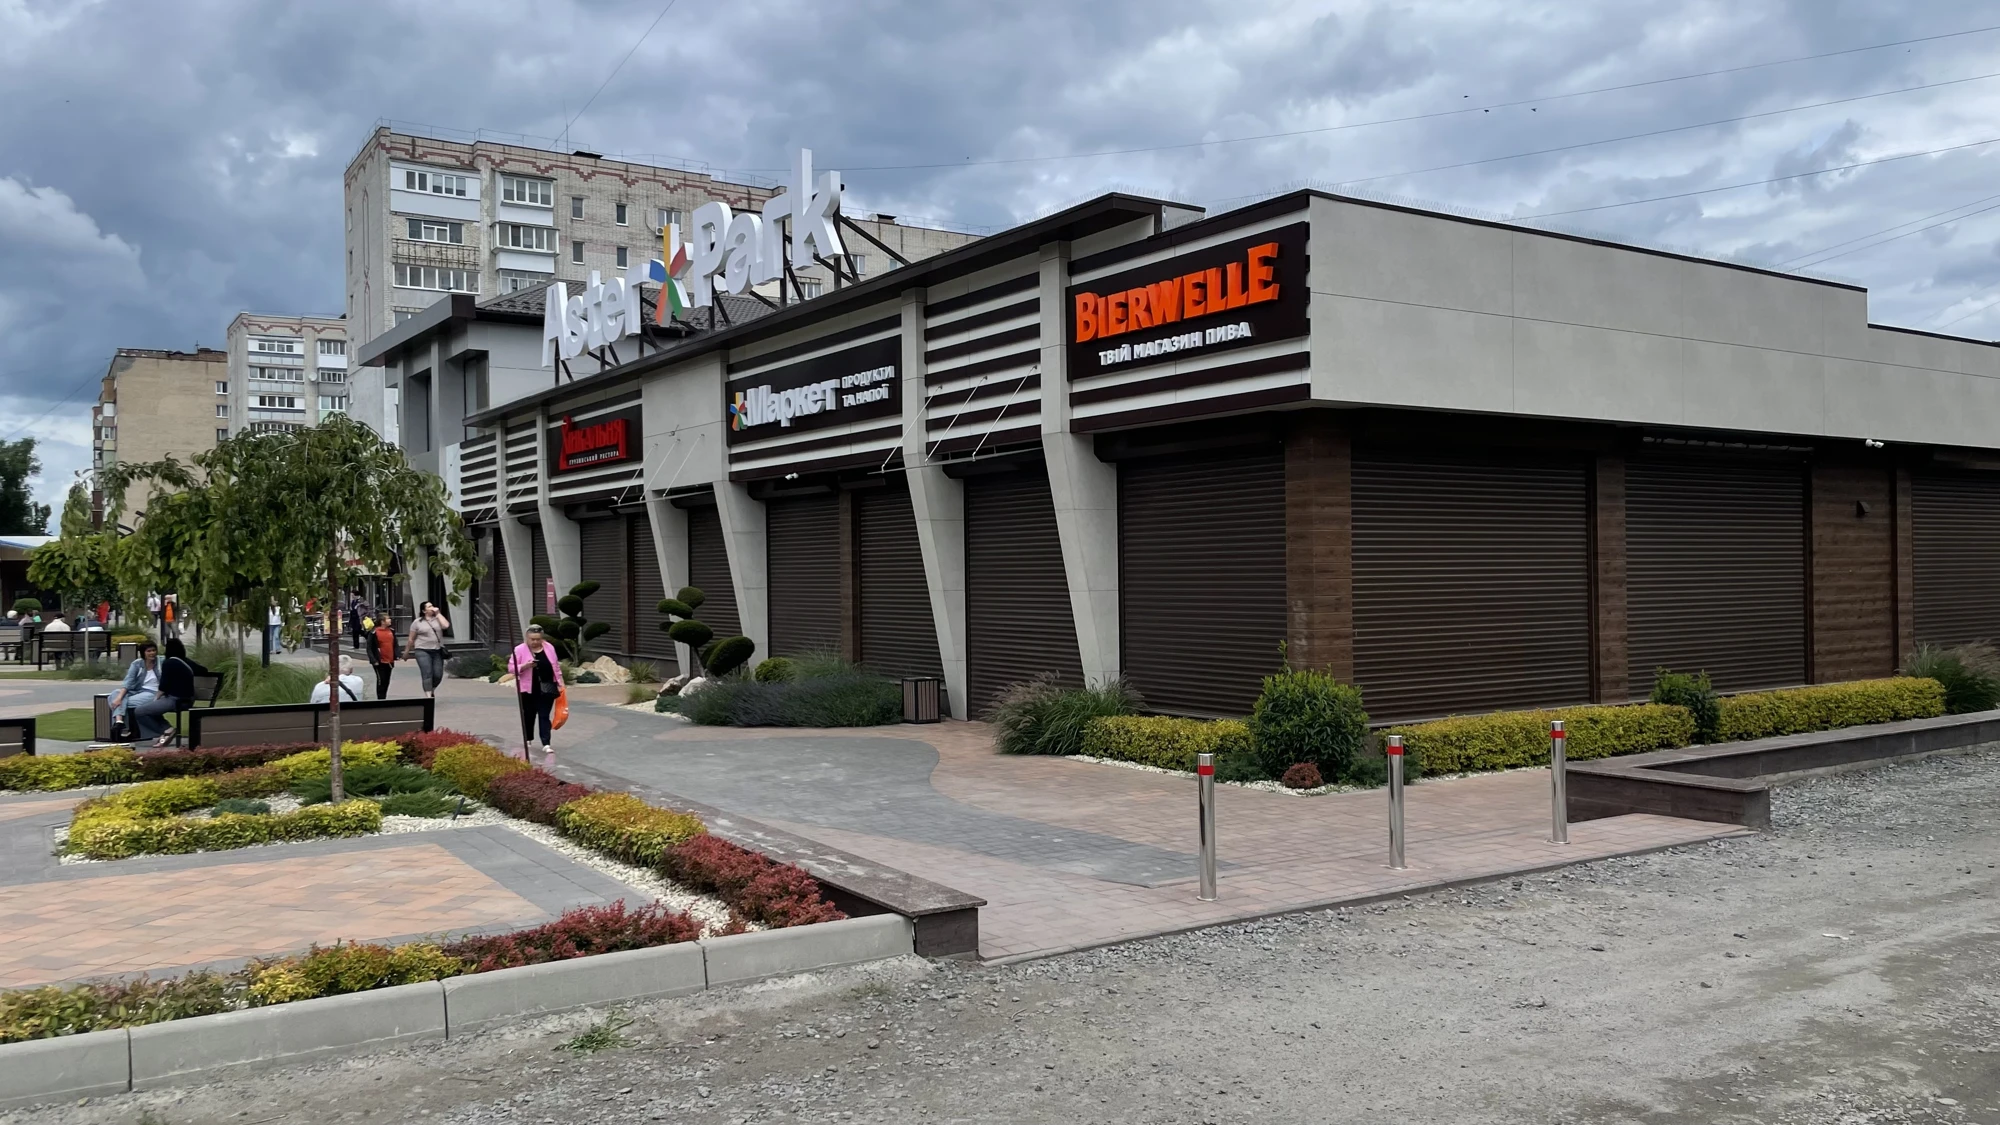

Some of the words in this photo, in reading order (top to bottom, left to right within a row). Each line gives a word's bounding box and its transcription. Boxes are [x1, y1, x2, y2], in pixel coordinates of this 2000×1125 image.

[542, 263, 650, 367] Aster
[692, 148, 844, 309] Park
[1075, 242, 1280, 343] BIERWELLE
[1099, 343, 1131, 366] ТВІЙ
[1133, 331, 1203, 359] МАГАЗИН
[1205, 322, 1252, 344] ПИВА
[842, 366, 895, 388] ПРОДУКТИ
[842, 395, 856, 407] ТА
[856, 384, 889, 404] НАПОЇ
[747, 379, 840, 427] Маркет
